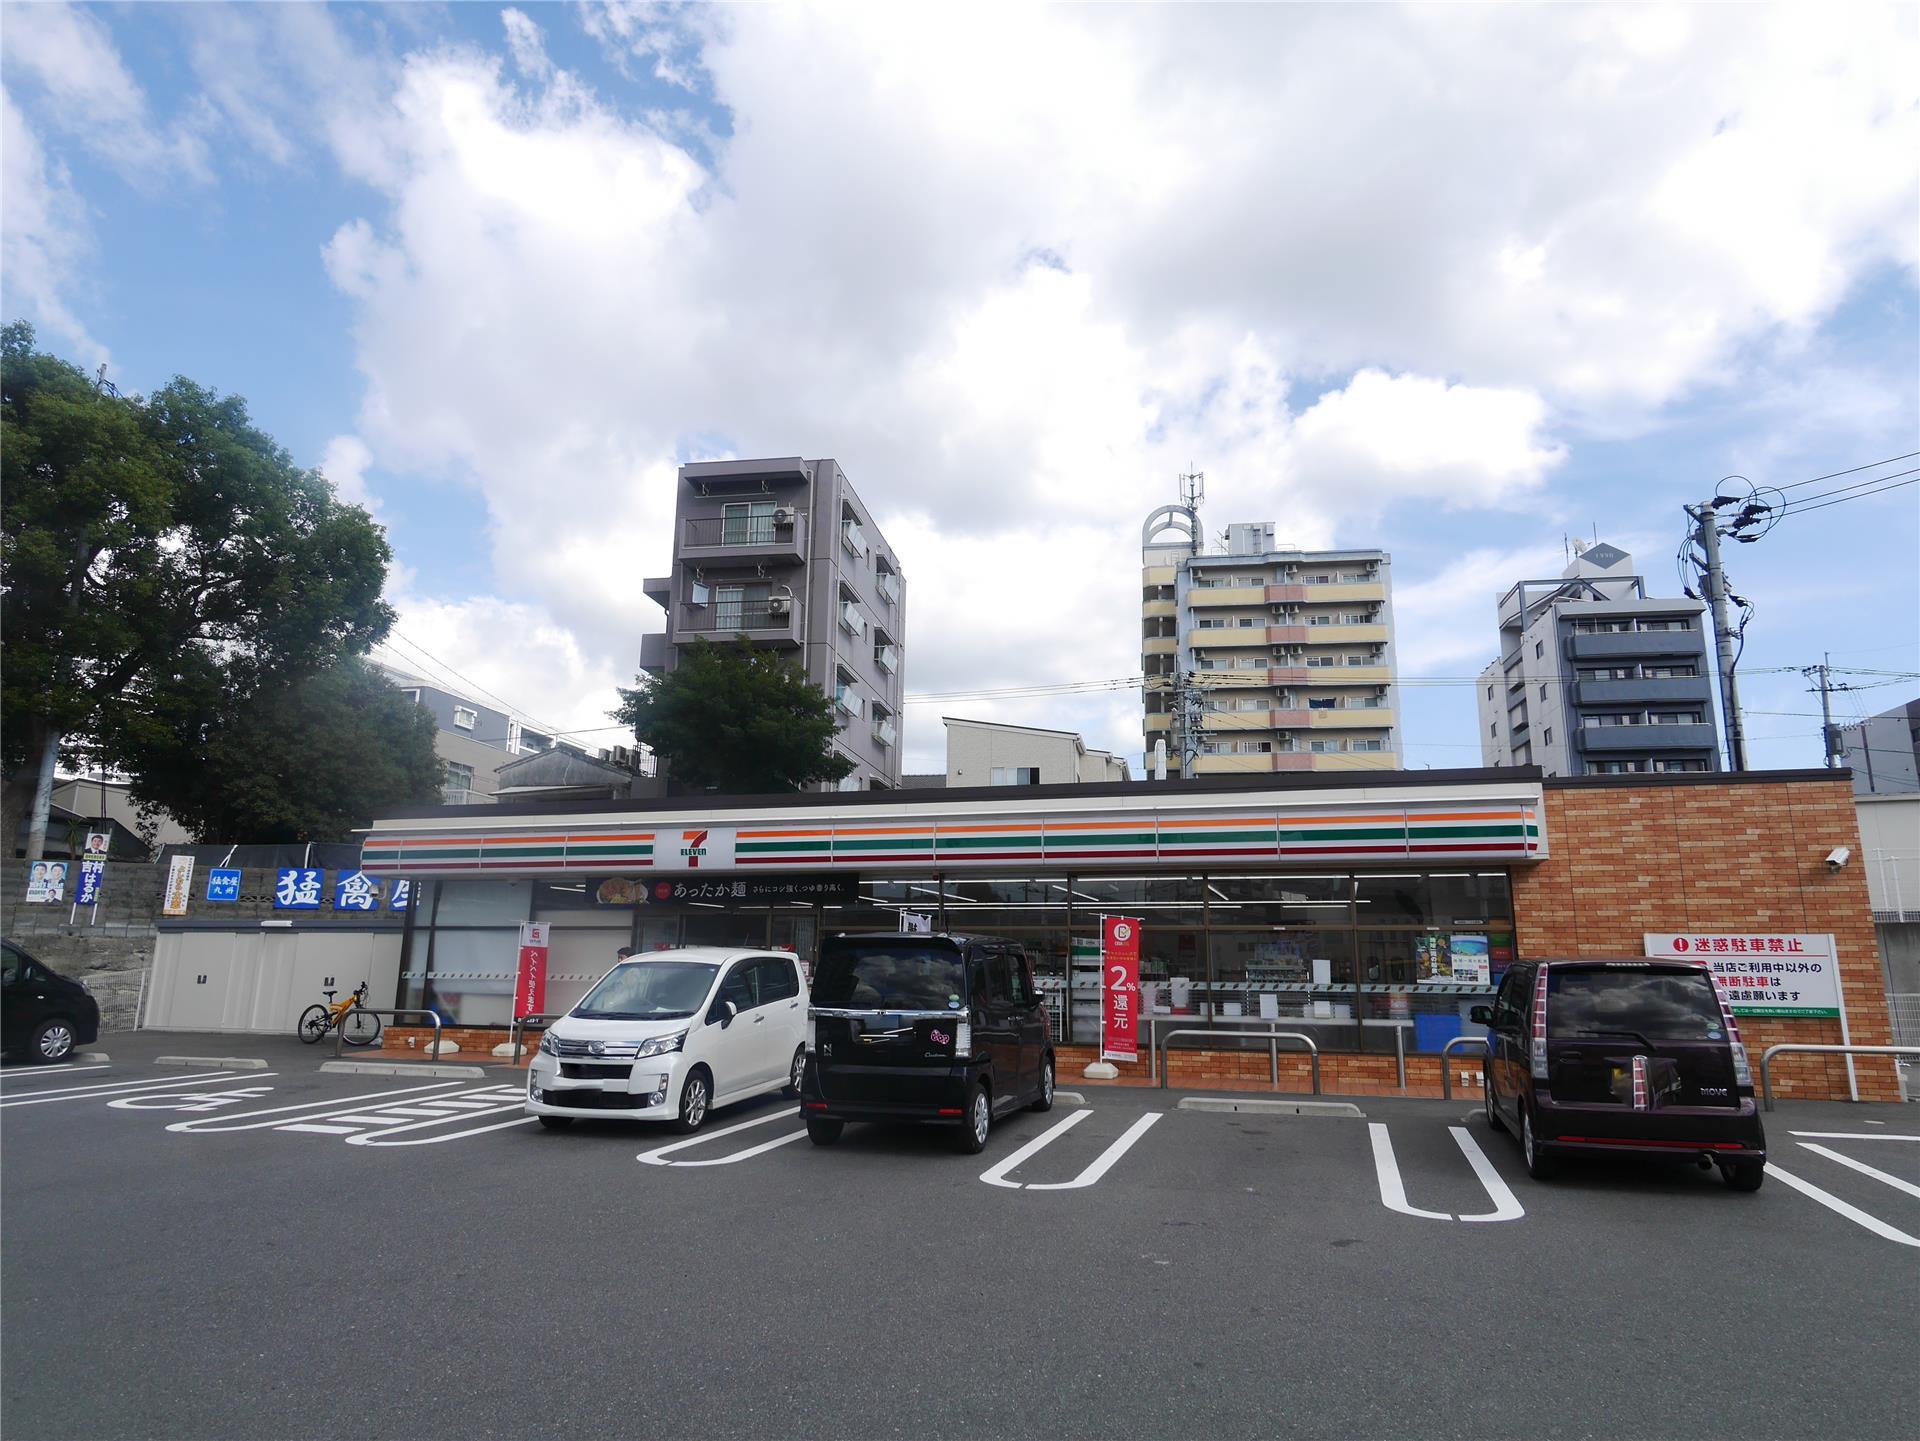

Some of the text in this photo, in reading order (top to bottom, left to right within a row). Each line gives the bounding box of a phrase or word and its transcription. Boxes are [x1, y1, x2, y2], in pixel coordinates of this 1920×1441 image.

[683, 830, 708, 867] 7
[82, 861, 105, 873] 吉村
[80, 873, 97, 903] はるか
[674, 881, 747, 898] あったか麺
[1695, 938, 1804, 953] 迷惑駐車禁止
[1713, 962, 1822, 974] 当店ご利用中以外の
[1110, 965, 1136, 992] 2%
[1724, 990, 1801, 1002] 遠慮願います
[1113, 994, 1129, 1029] 還元
